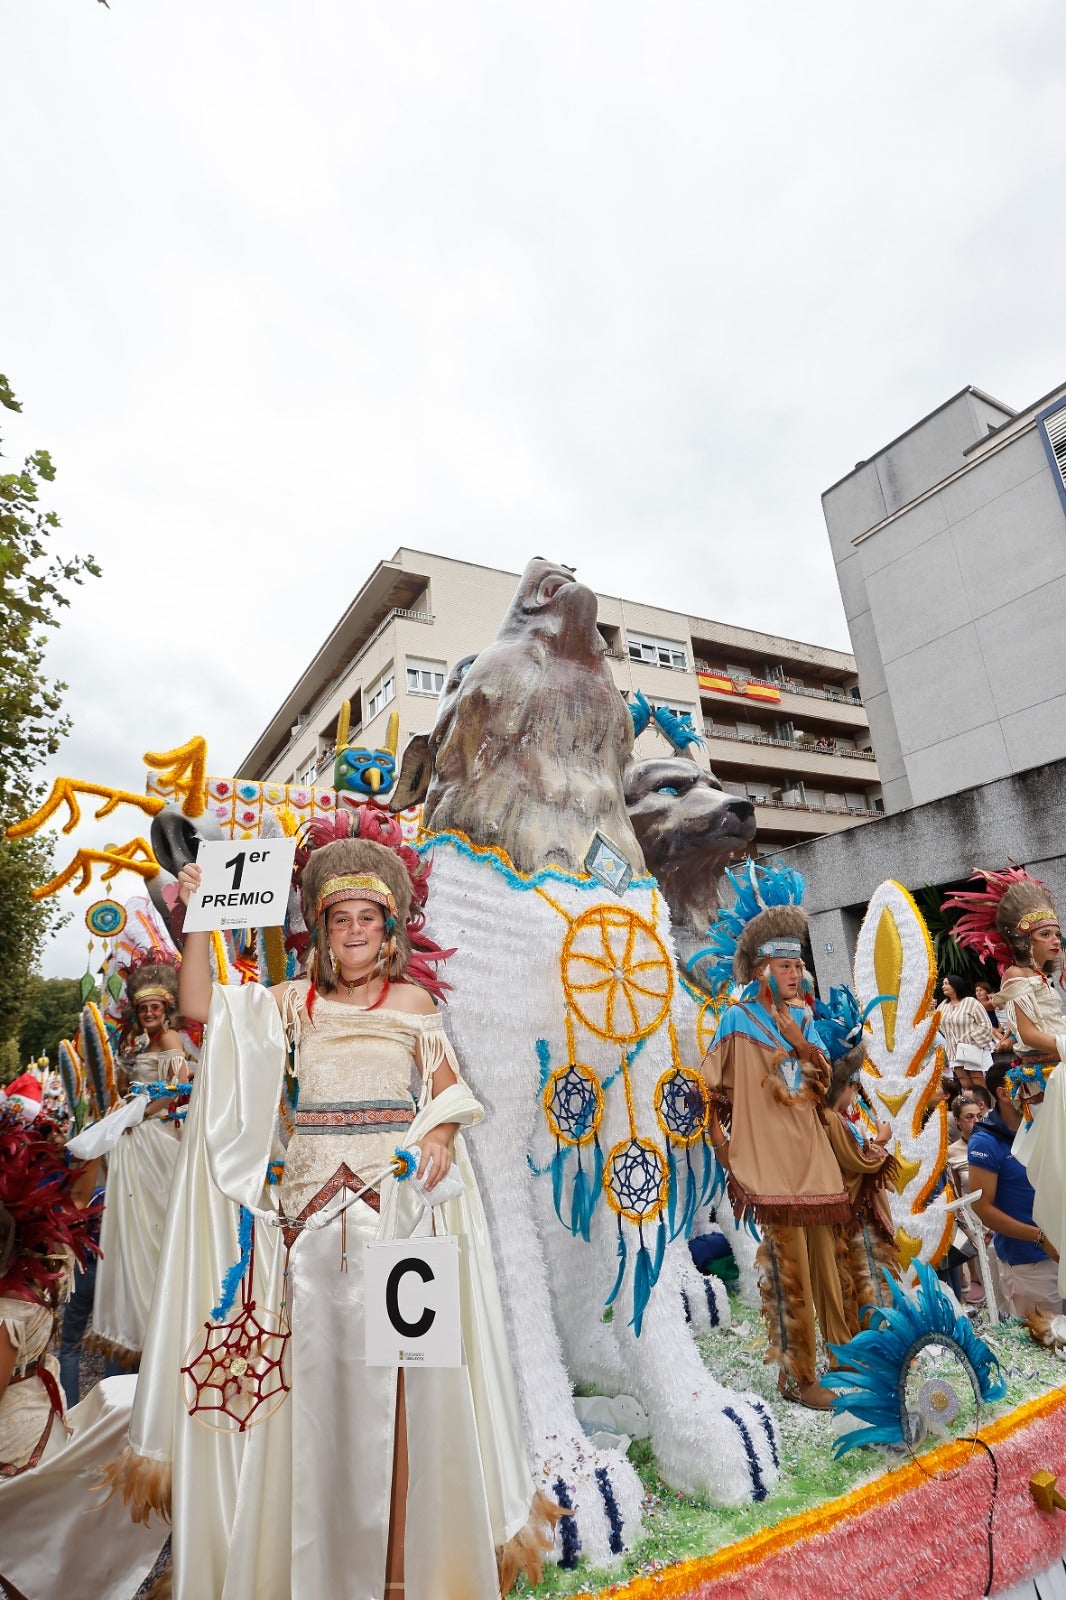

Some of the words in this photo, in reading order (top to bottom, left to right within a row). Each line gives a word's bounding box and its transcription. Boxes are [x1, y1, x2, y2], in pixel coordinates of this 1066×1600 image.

[225, 850, 271, 890] 1er
[201, 890, 274, 908] PREMIO
[386, 1257, 436, 1338] C
